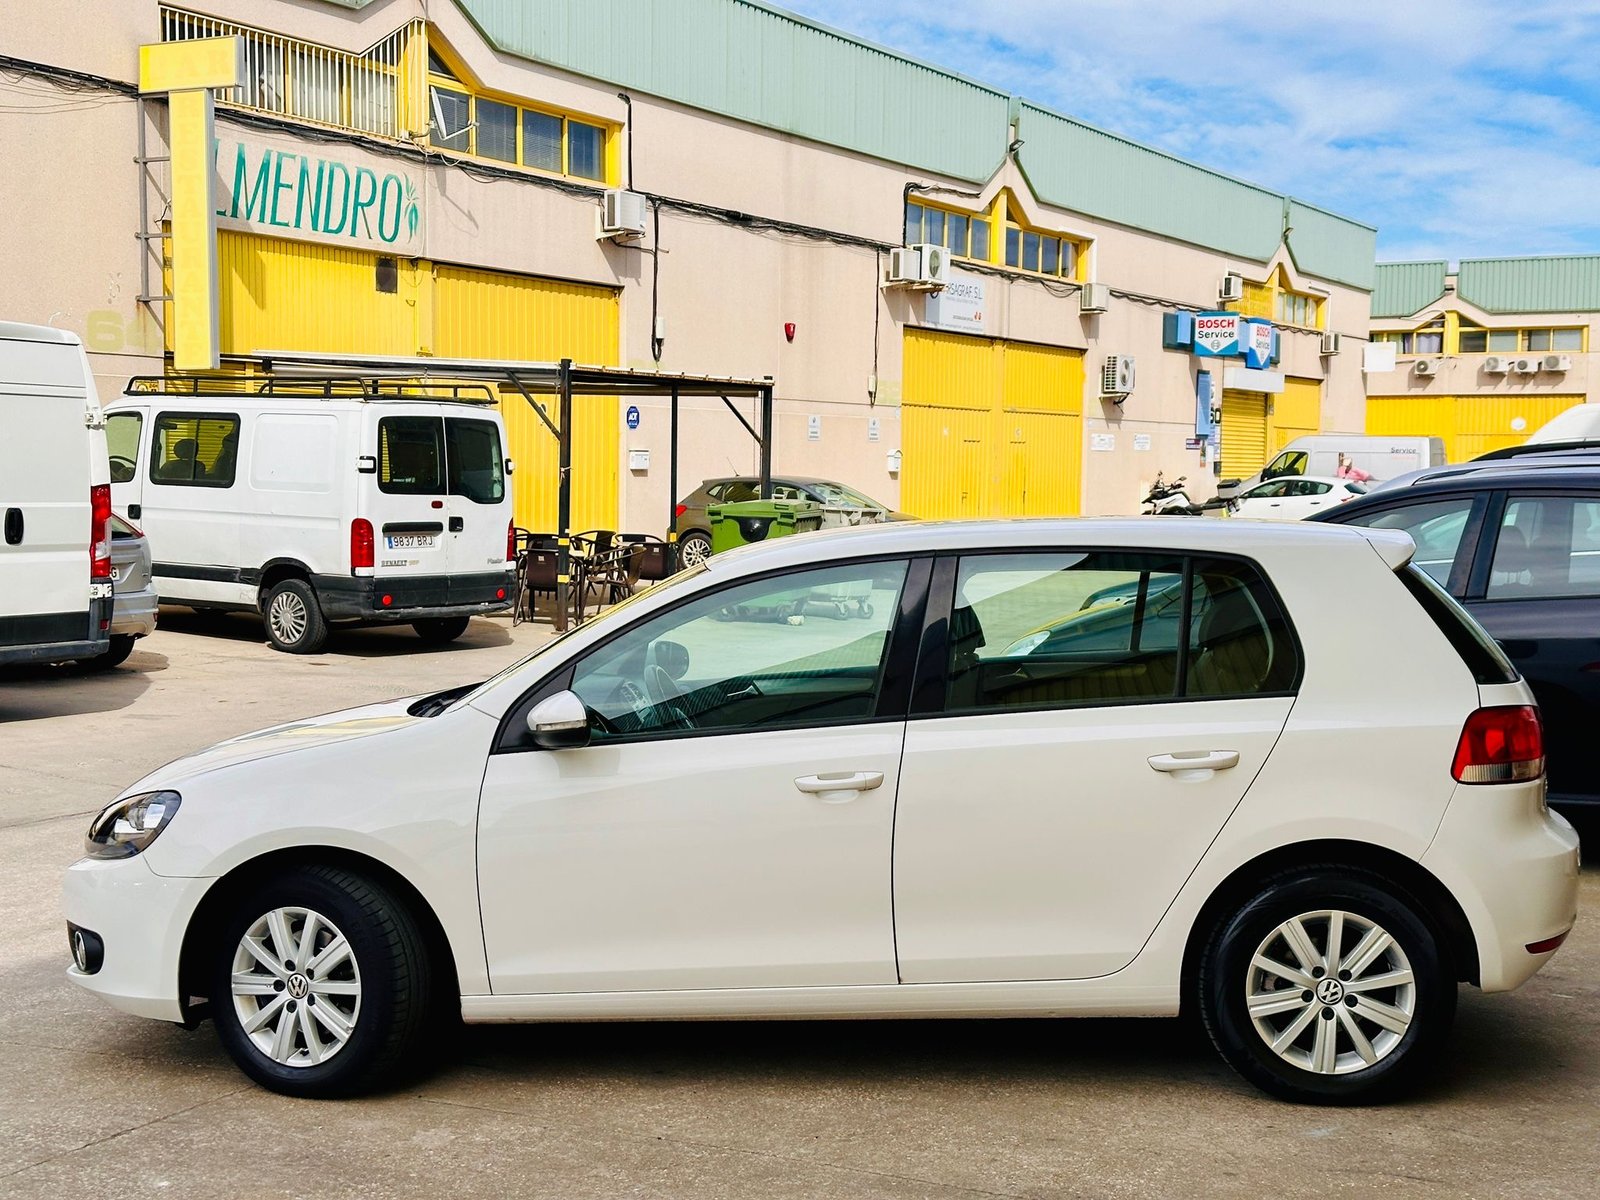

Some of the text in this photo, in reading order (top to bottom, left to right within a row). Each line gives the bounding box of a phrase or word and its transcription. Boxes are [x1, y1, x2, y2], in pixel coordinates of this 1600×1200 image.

[1198, 319, 1235, 329] BOSCH
[1198, 330, 1235, 339] Service
[1256, 325, 1270, 337] BOSCH
[1256, 338, 1270, 350] Service
[1390, 446, 1417, 454] Service
[393, 535, 433, 547] 9837 BRJ
